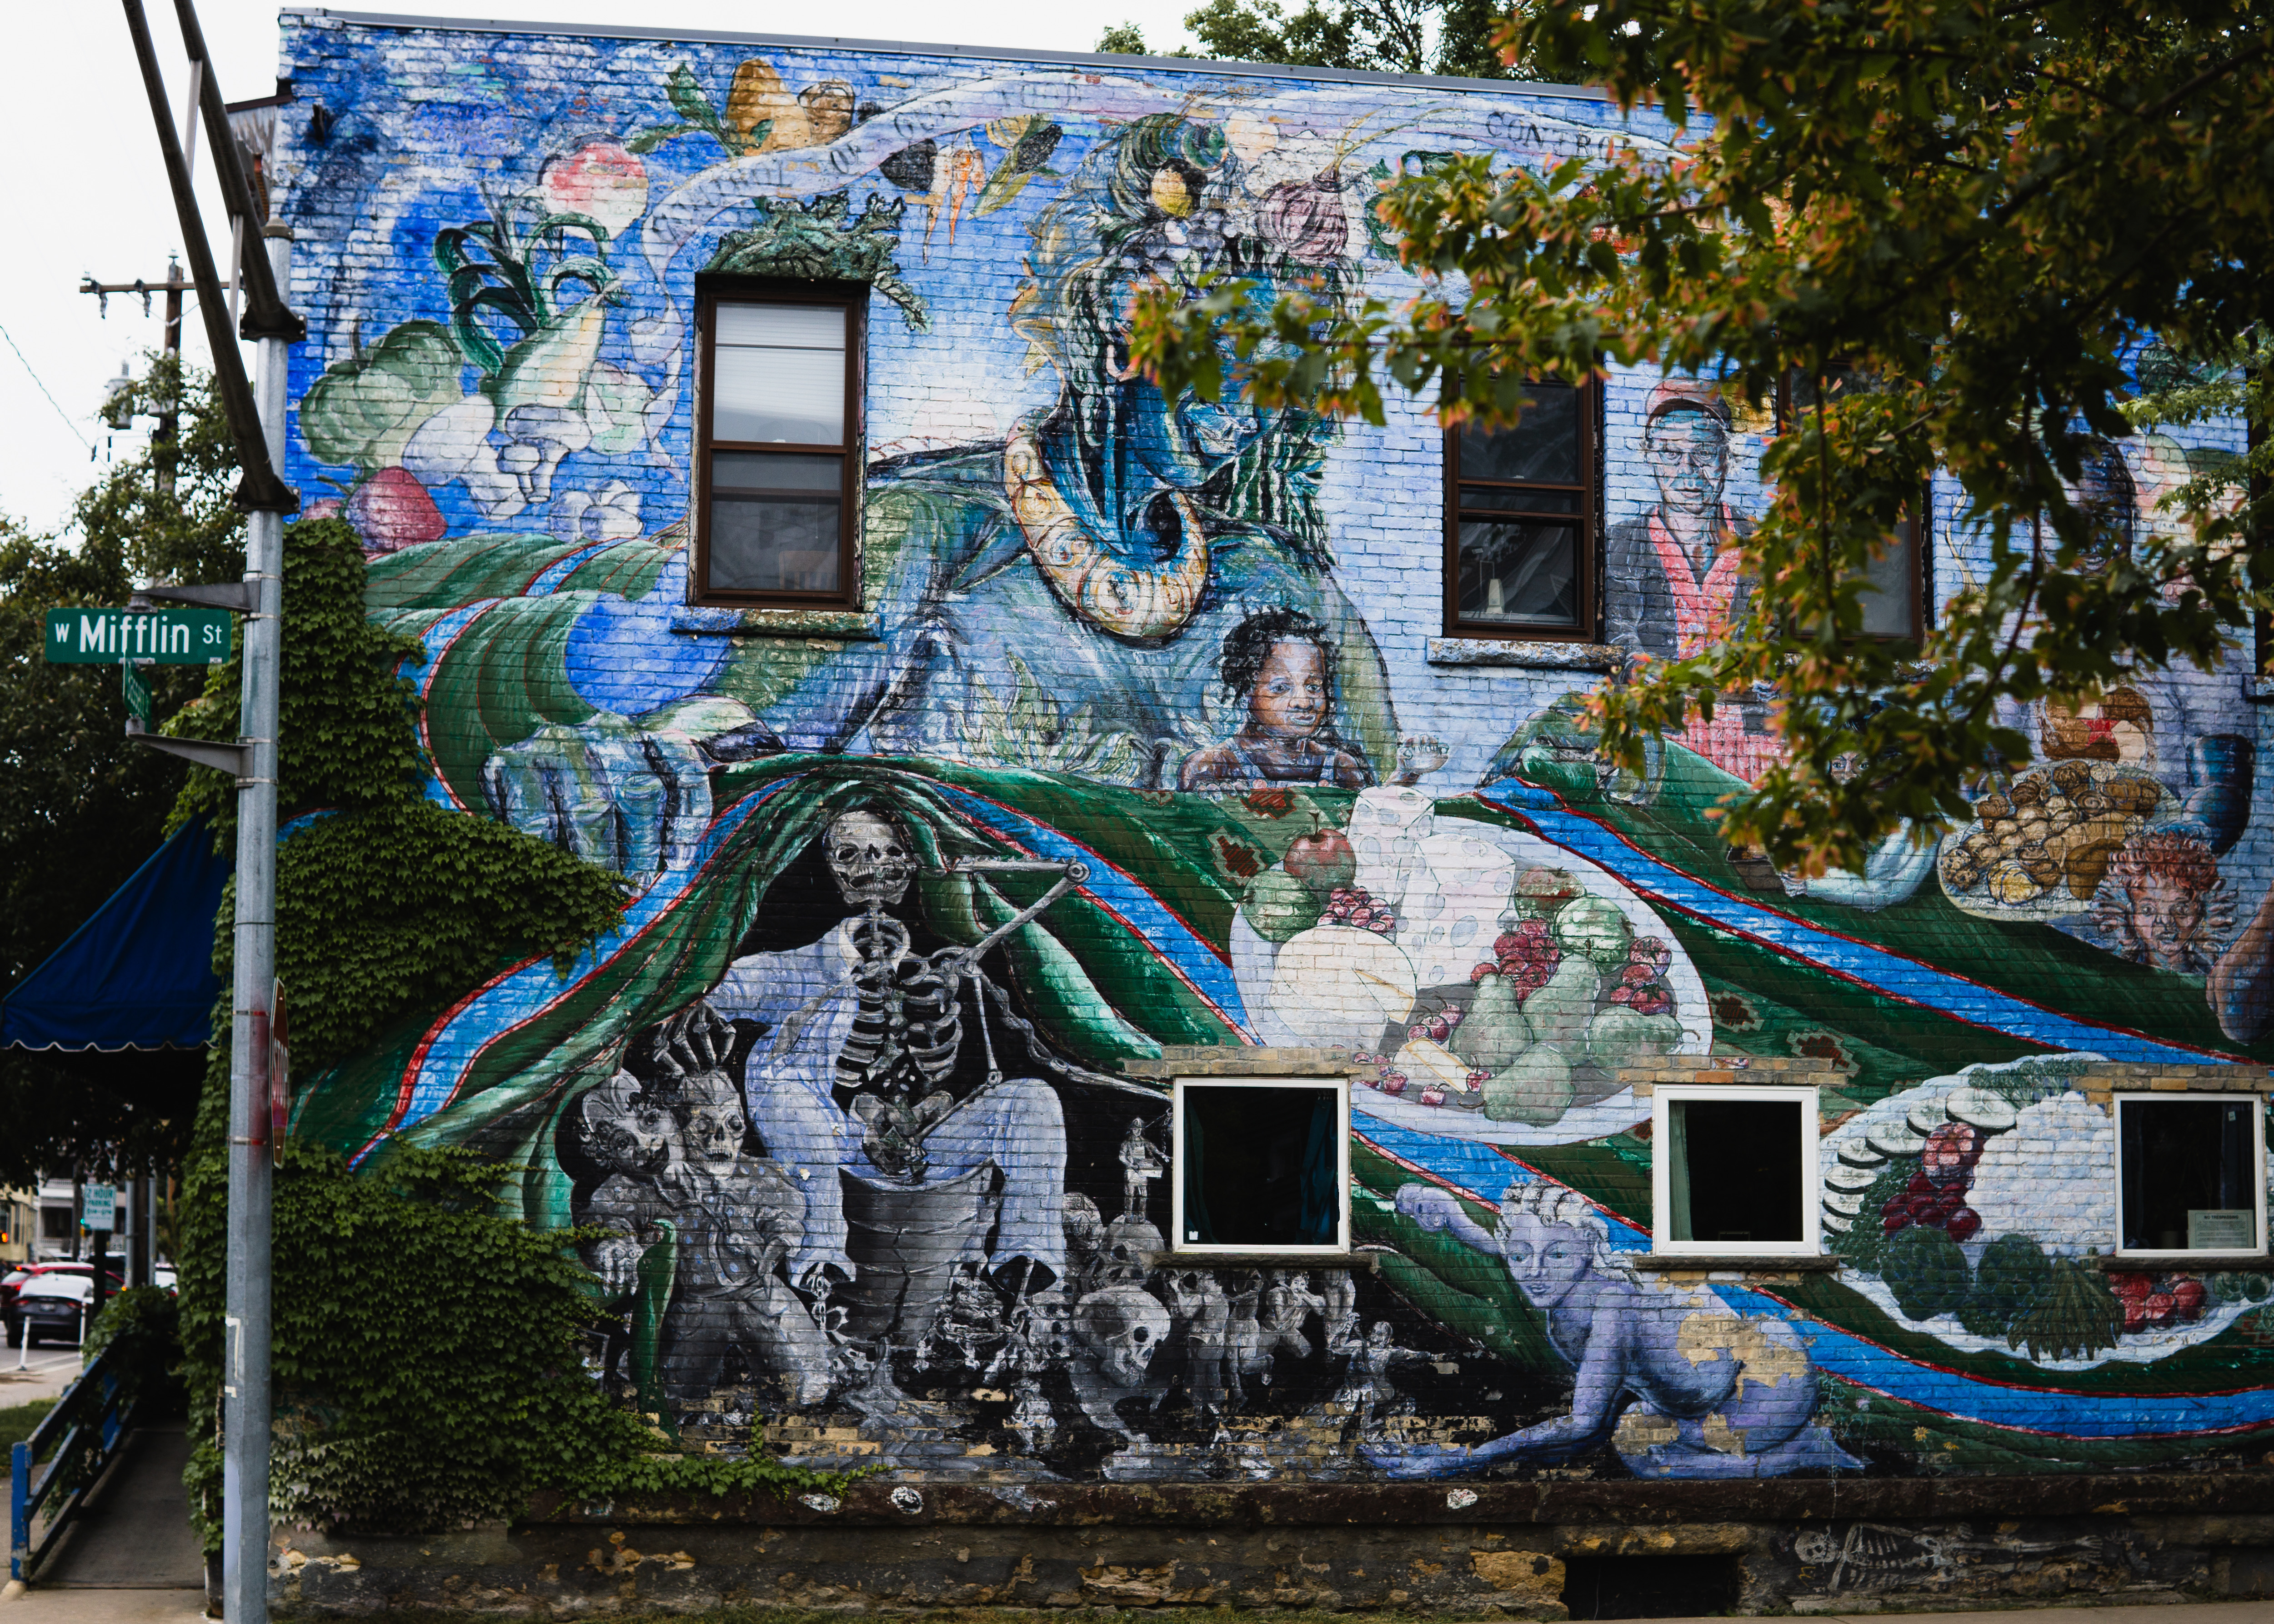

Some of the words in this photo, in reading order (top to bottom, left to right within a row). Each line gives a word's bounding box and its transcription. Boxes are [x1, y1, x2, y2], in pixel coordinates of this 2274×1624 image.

[1485, 111, 1631, 159] CONTRO
[55, 623, 70, 643] W
[79, 615, 189, 653] Mifflin
[203, 624, 222, 644] St
[86, 1188, 91, 1198] 2
[94, 1188, 113, 1198] HOUR
